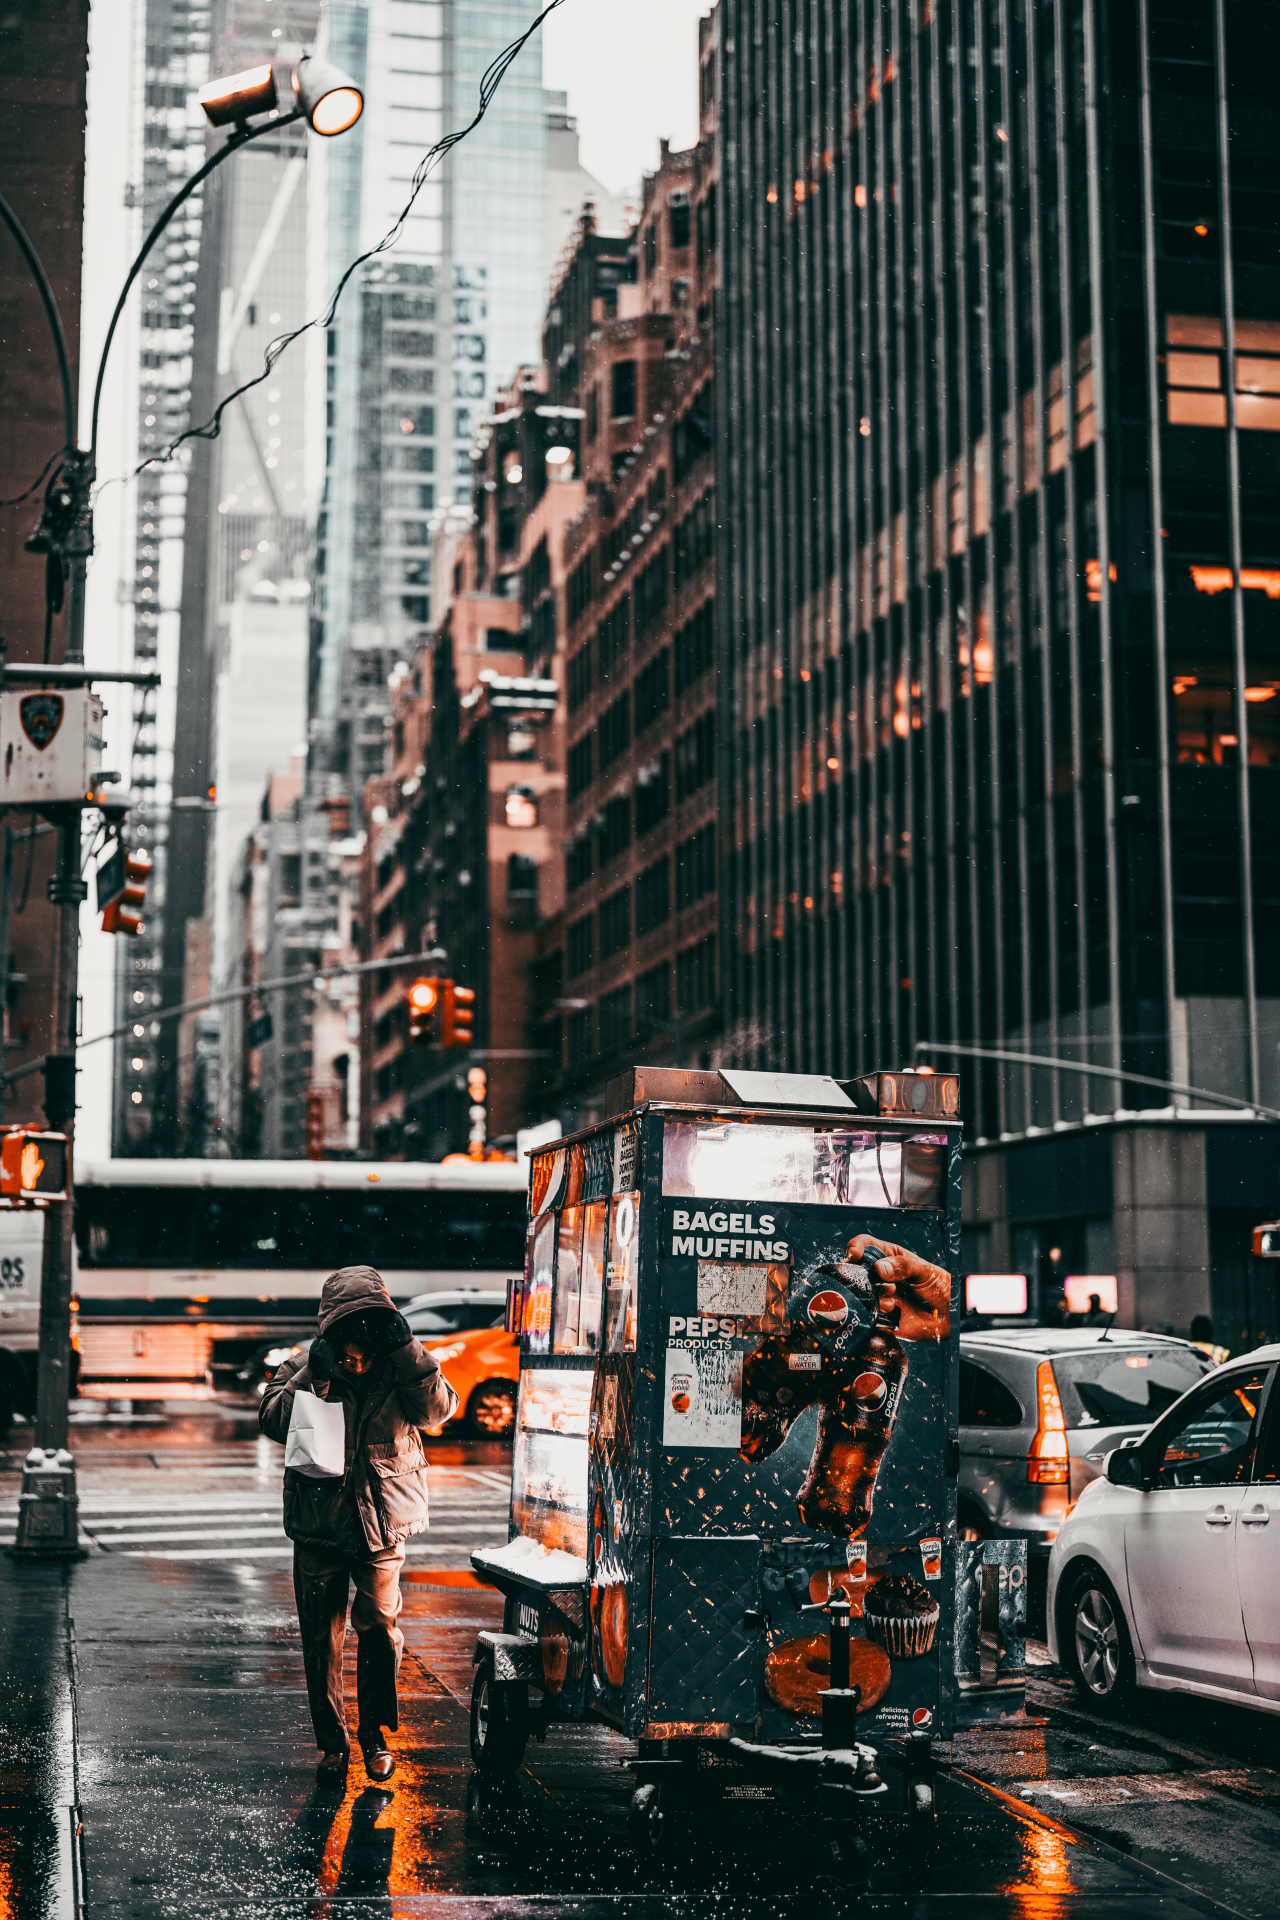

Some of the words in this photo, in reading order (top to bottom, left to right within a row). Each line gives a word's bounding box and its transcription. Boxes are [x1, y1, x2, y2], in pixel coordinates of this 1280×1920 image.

[673, 1210, 776, 1235] BAGELS
[672, 1236, 789, 1261] MUFFINS
[669, 1316, 743, 1339] PEPSI
[836, 1313, 861, 1349] pepsi
[668, 1338, 732, 1350] PRODUCTS
[884, 1382, 898, 1417] pepsi
[762, 1567, 810, 1591] GO
[998, 1565, 1027, 1594] ep
[519, 1604, 539, 1632] NUTS
[876, 1714, 910, 1723] refreshing.
[881, 1706, 910, 1714] delicious.
